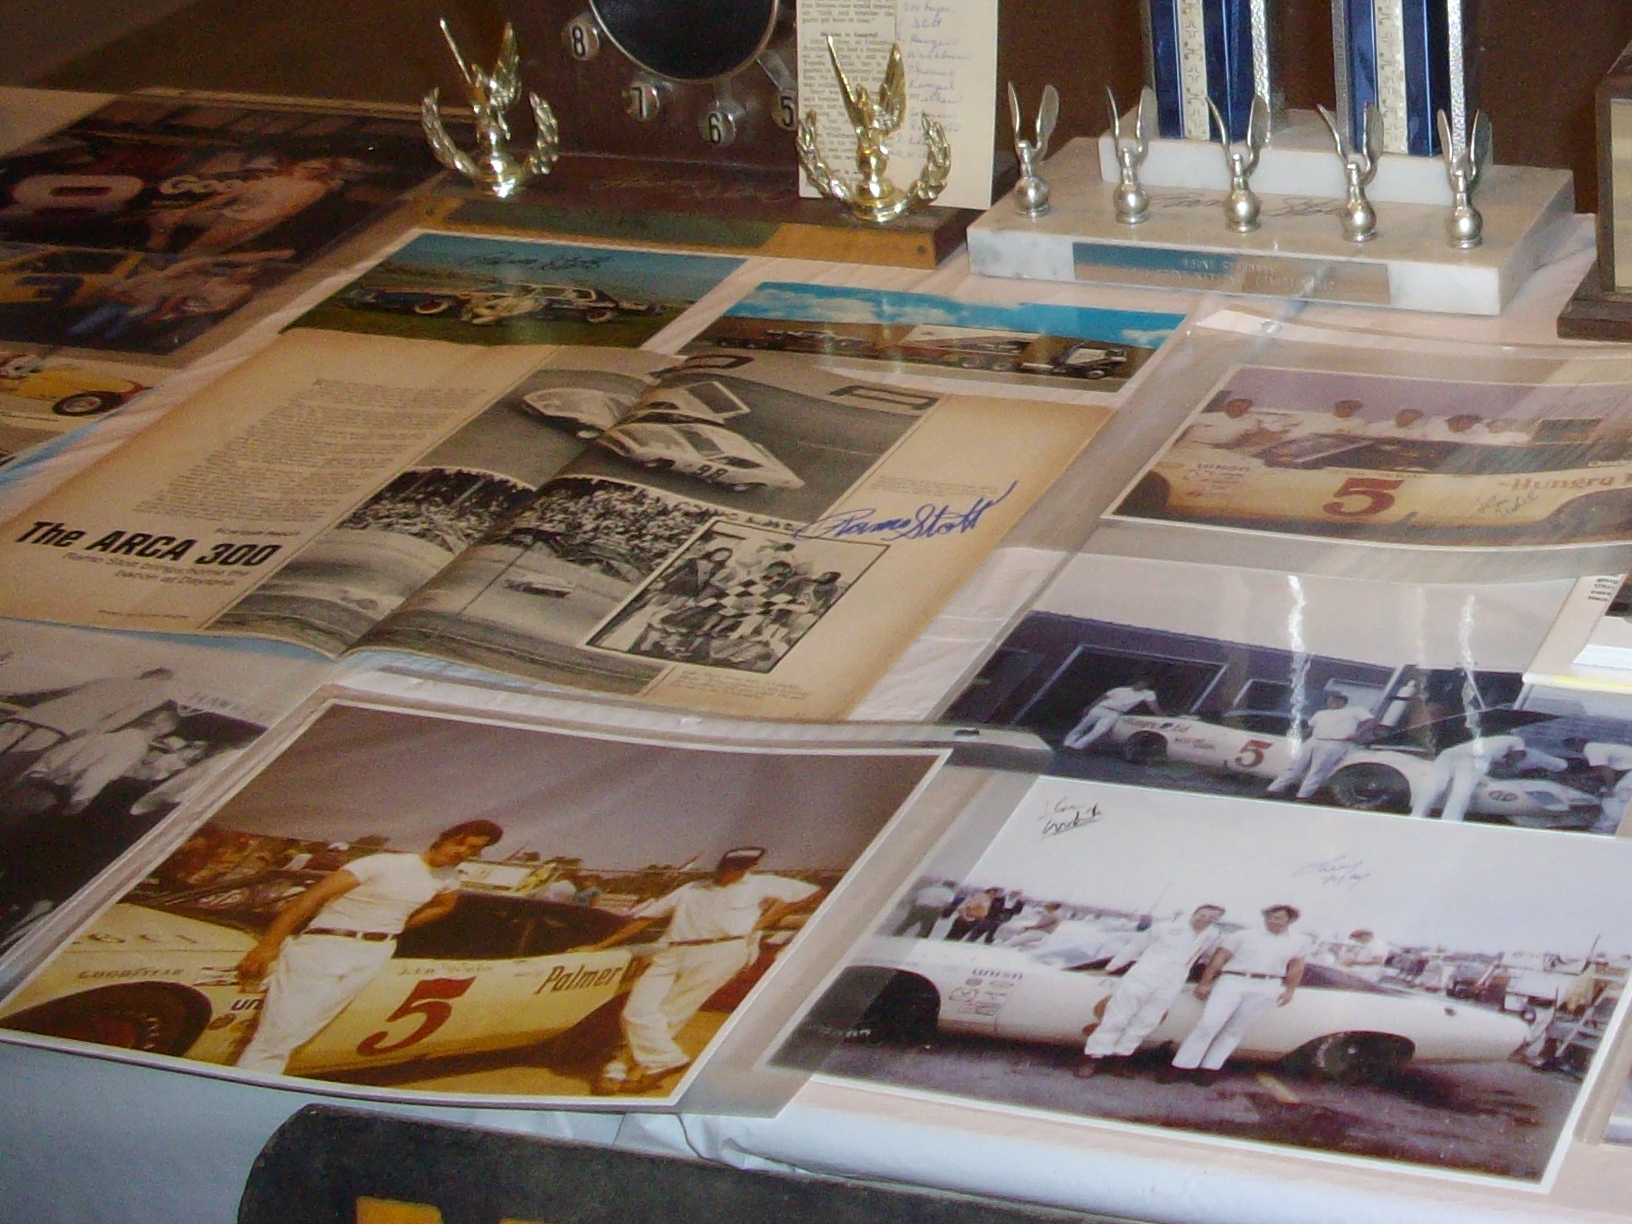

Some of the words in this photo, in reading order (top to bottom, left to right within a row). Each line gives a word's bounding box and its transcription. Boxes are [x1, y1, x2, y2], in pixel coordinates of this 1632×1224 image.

[570, 26, 586, 58] 8
[630, 86, 644, 119] 7
[780, 95, 795, 127] 5
[707, 111, 722, 144] 6
[1322, 476, 1405, 518] 5
[15, 521, 86, 548] The
[85, 530, 199, 562] ARCA
[194, 543, 283, 567] 300
[1234, 739, 1274, 768] 5
[533, 964, 624, 995] Palmer
[355, 976, 477, 1058] 5
